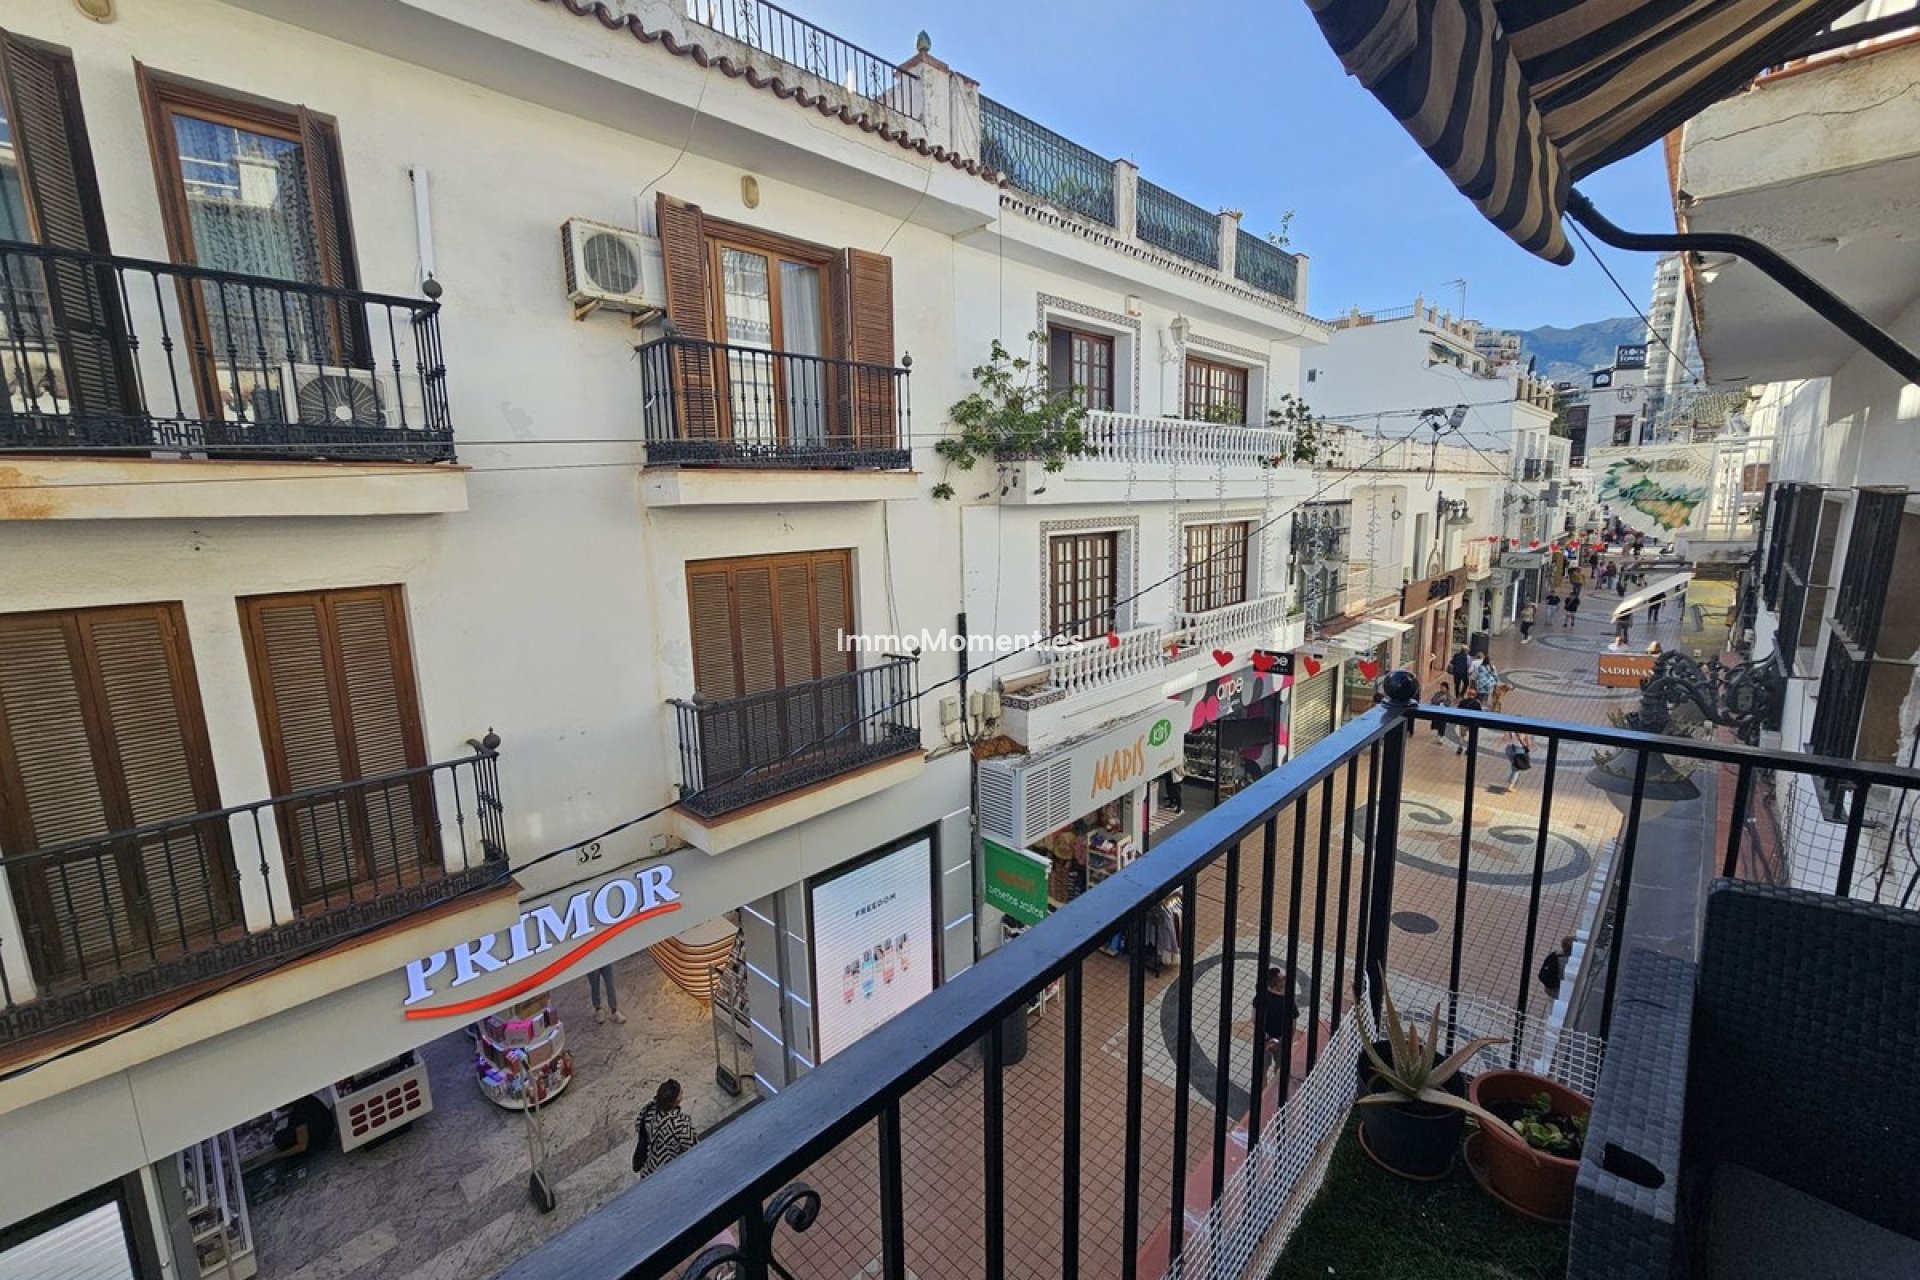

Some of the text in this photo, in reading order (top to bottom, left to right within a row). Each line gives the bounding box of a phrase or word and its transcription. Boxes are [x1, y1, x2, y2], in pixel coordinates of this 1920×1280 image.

[1091, 735, 1145, 799] MADIS
[404, 864, 681, 1006] PRIMOR
[855, 892, 897, 918] FREEDOM
